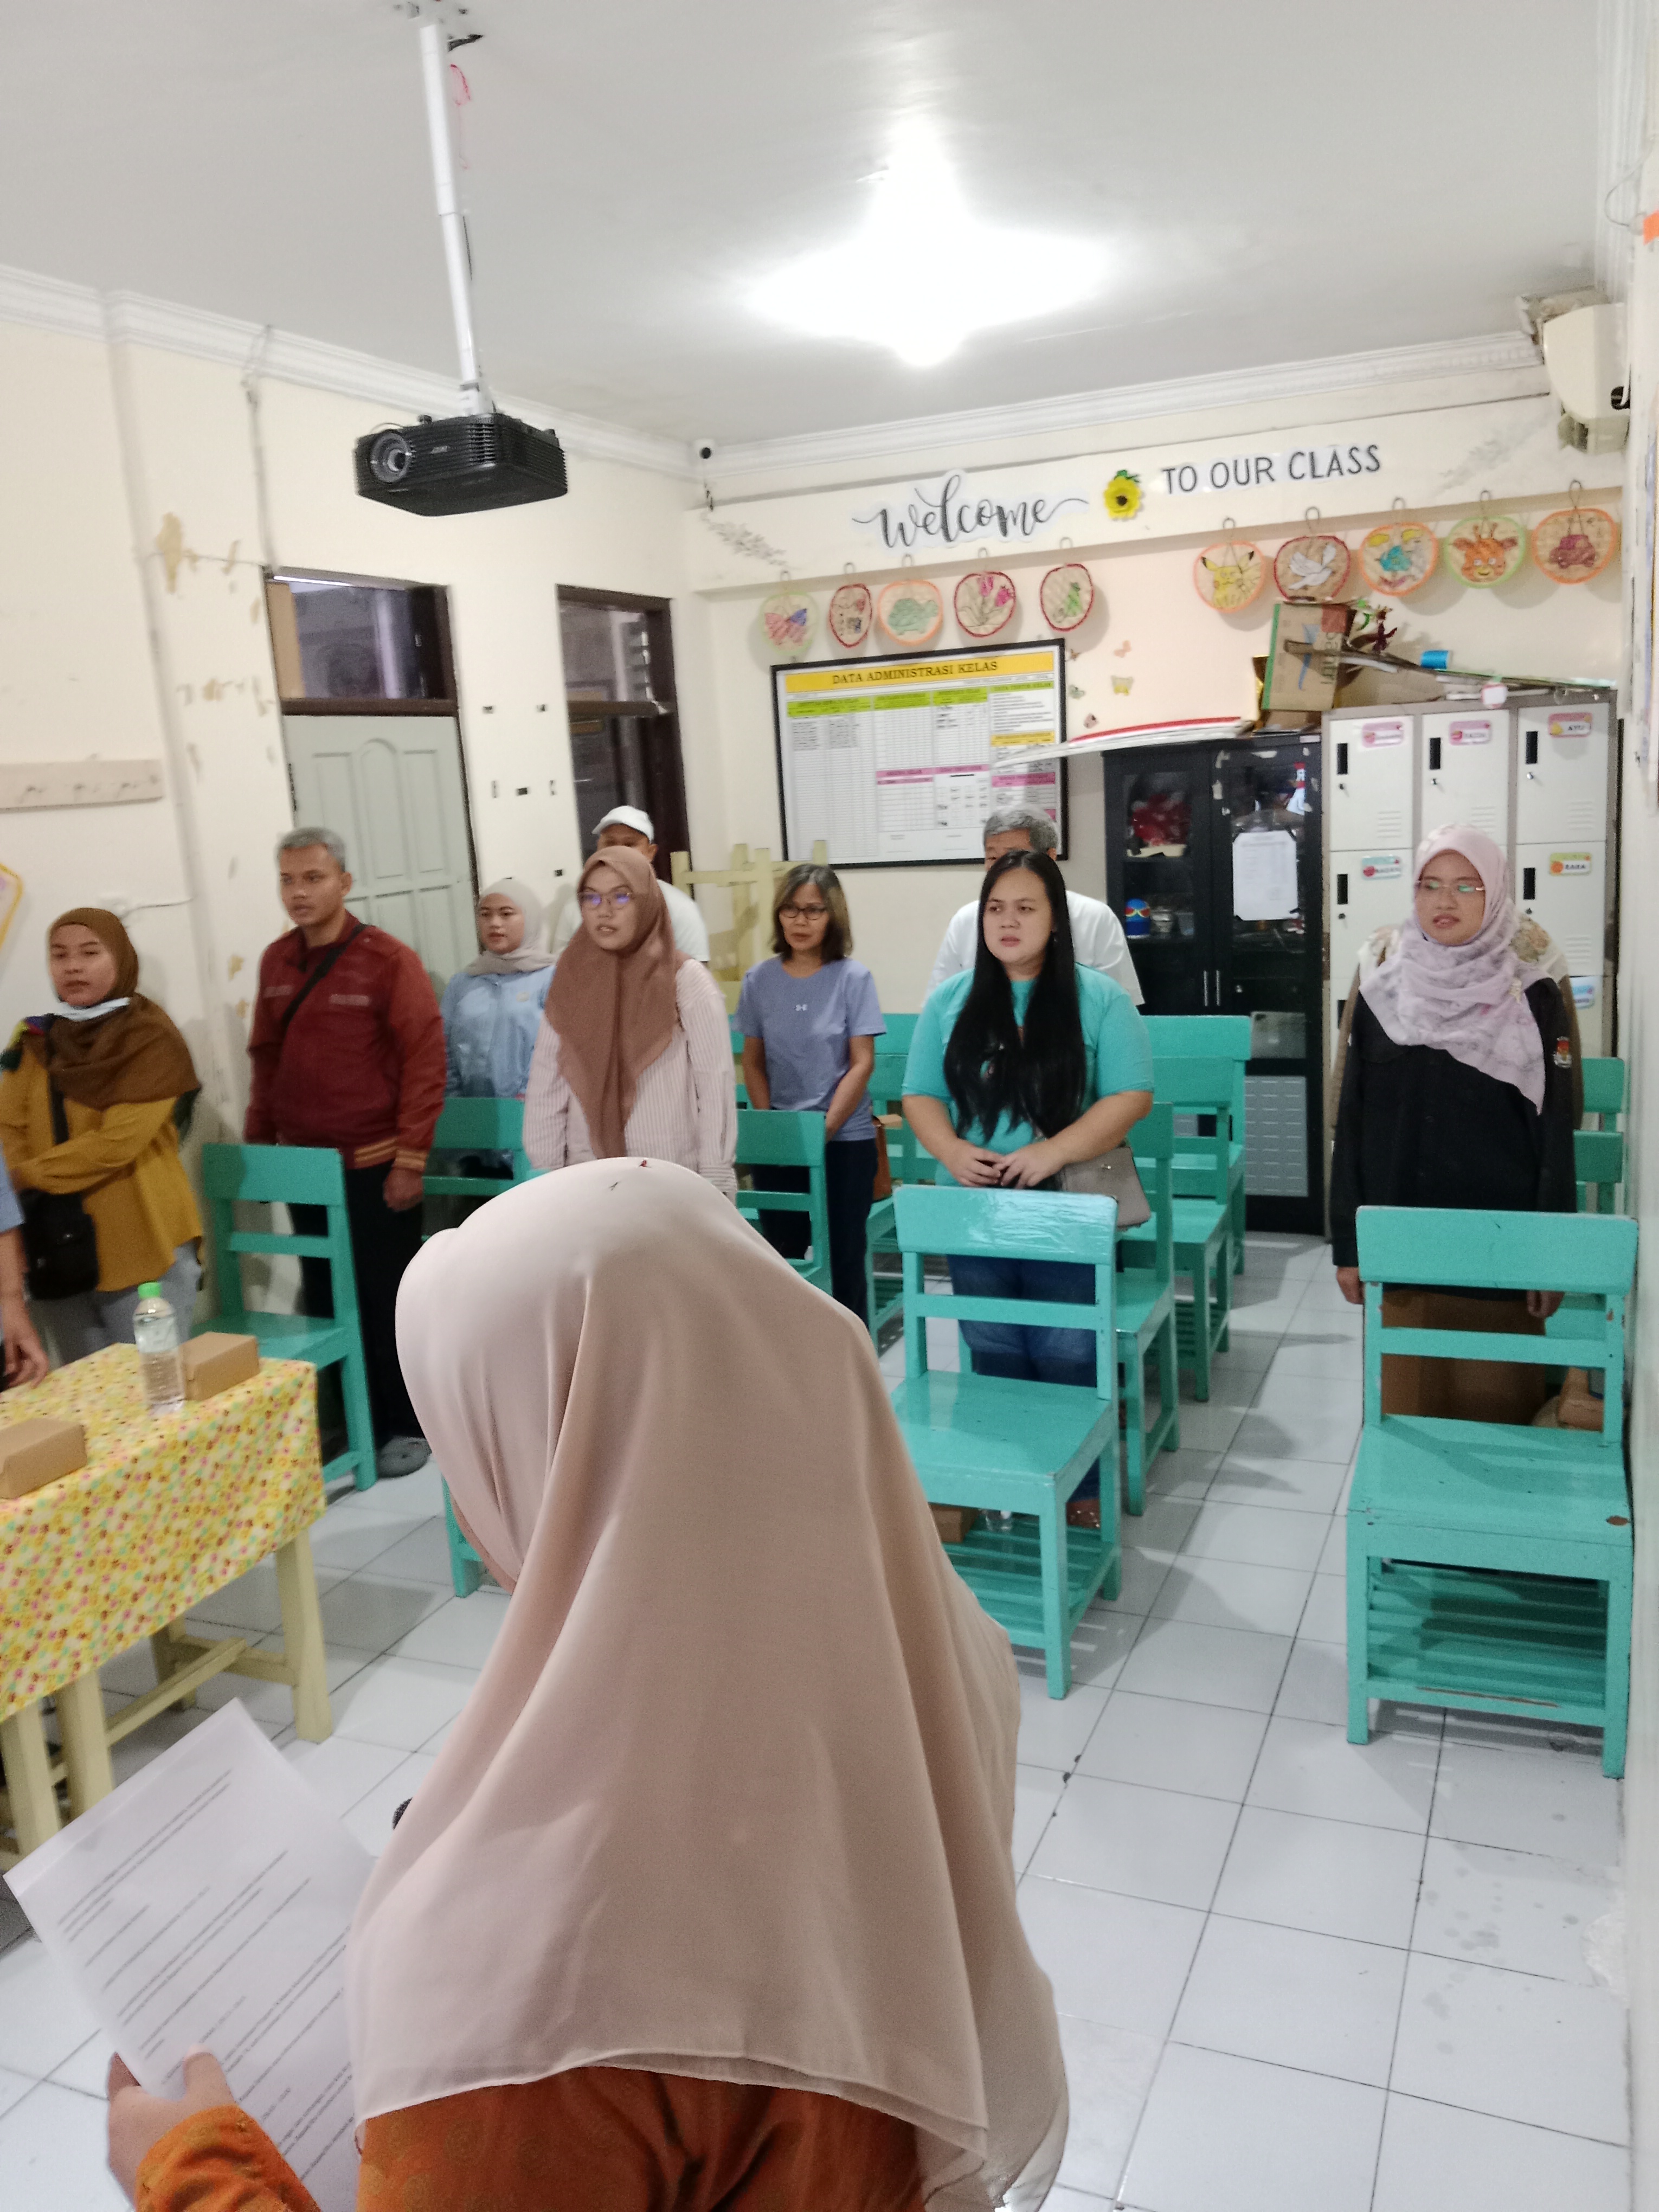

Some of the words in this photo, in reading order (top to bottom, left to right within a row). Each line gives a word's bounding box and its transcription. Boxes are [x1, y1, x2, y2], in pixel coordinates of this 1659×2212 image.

[1162, 466, 1197, 494] TO
[1210, 456, 1275, 489] OUR
[1288, 444, 1380, 480] CLASS
[833, 673, 863, 684] DATA
[867, 665, 953, 681] ADMINISTRASI
[958, 661, 997, 673] KELAS
